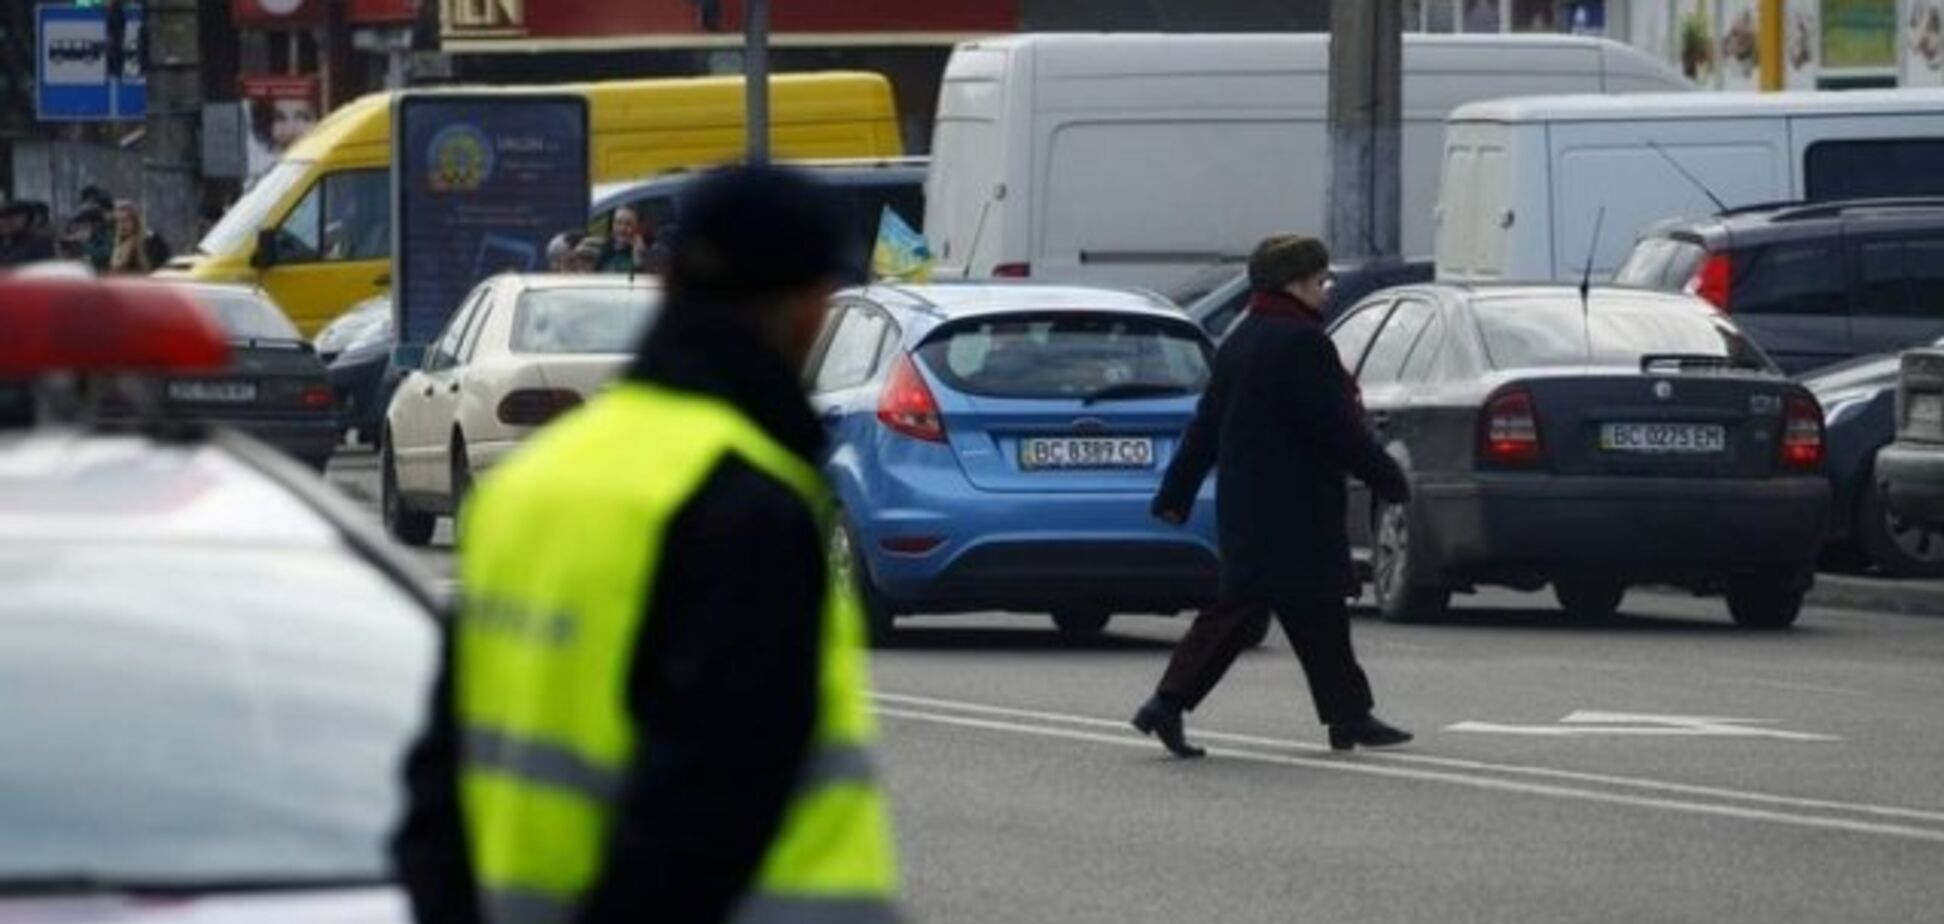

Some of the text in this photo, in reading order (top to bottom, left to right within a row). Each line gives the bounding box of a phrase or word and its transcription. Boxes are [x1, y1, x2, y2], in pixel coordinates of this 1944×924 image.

[1613, 424, 1640, 446] BC
[1034, 440, 1063, 461] BC
[1119, 440, 1149, 462] CO
